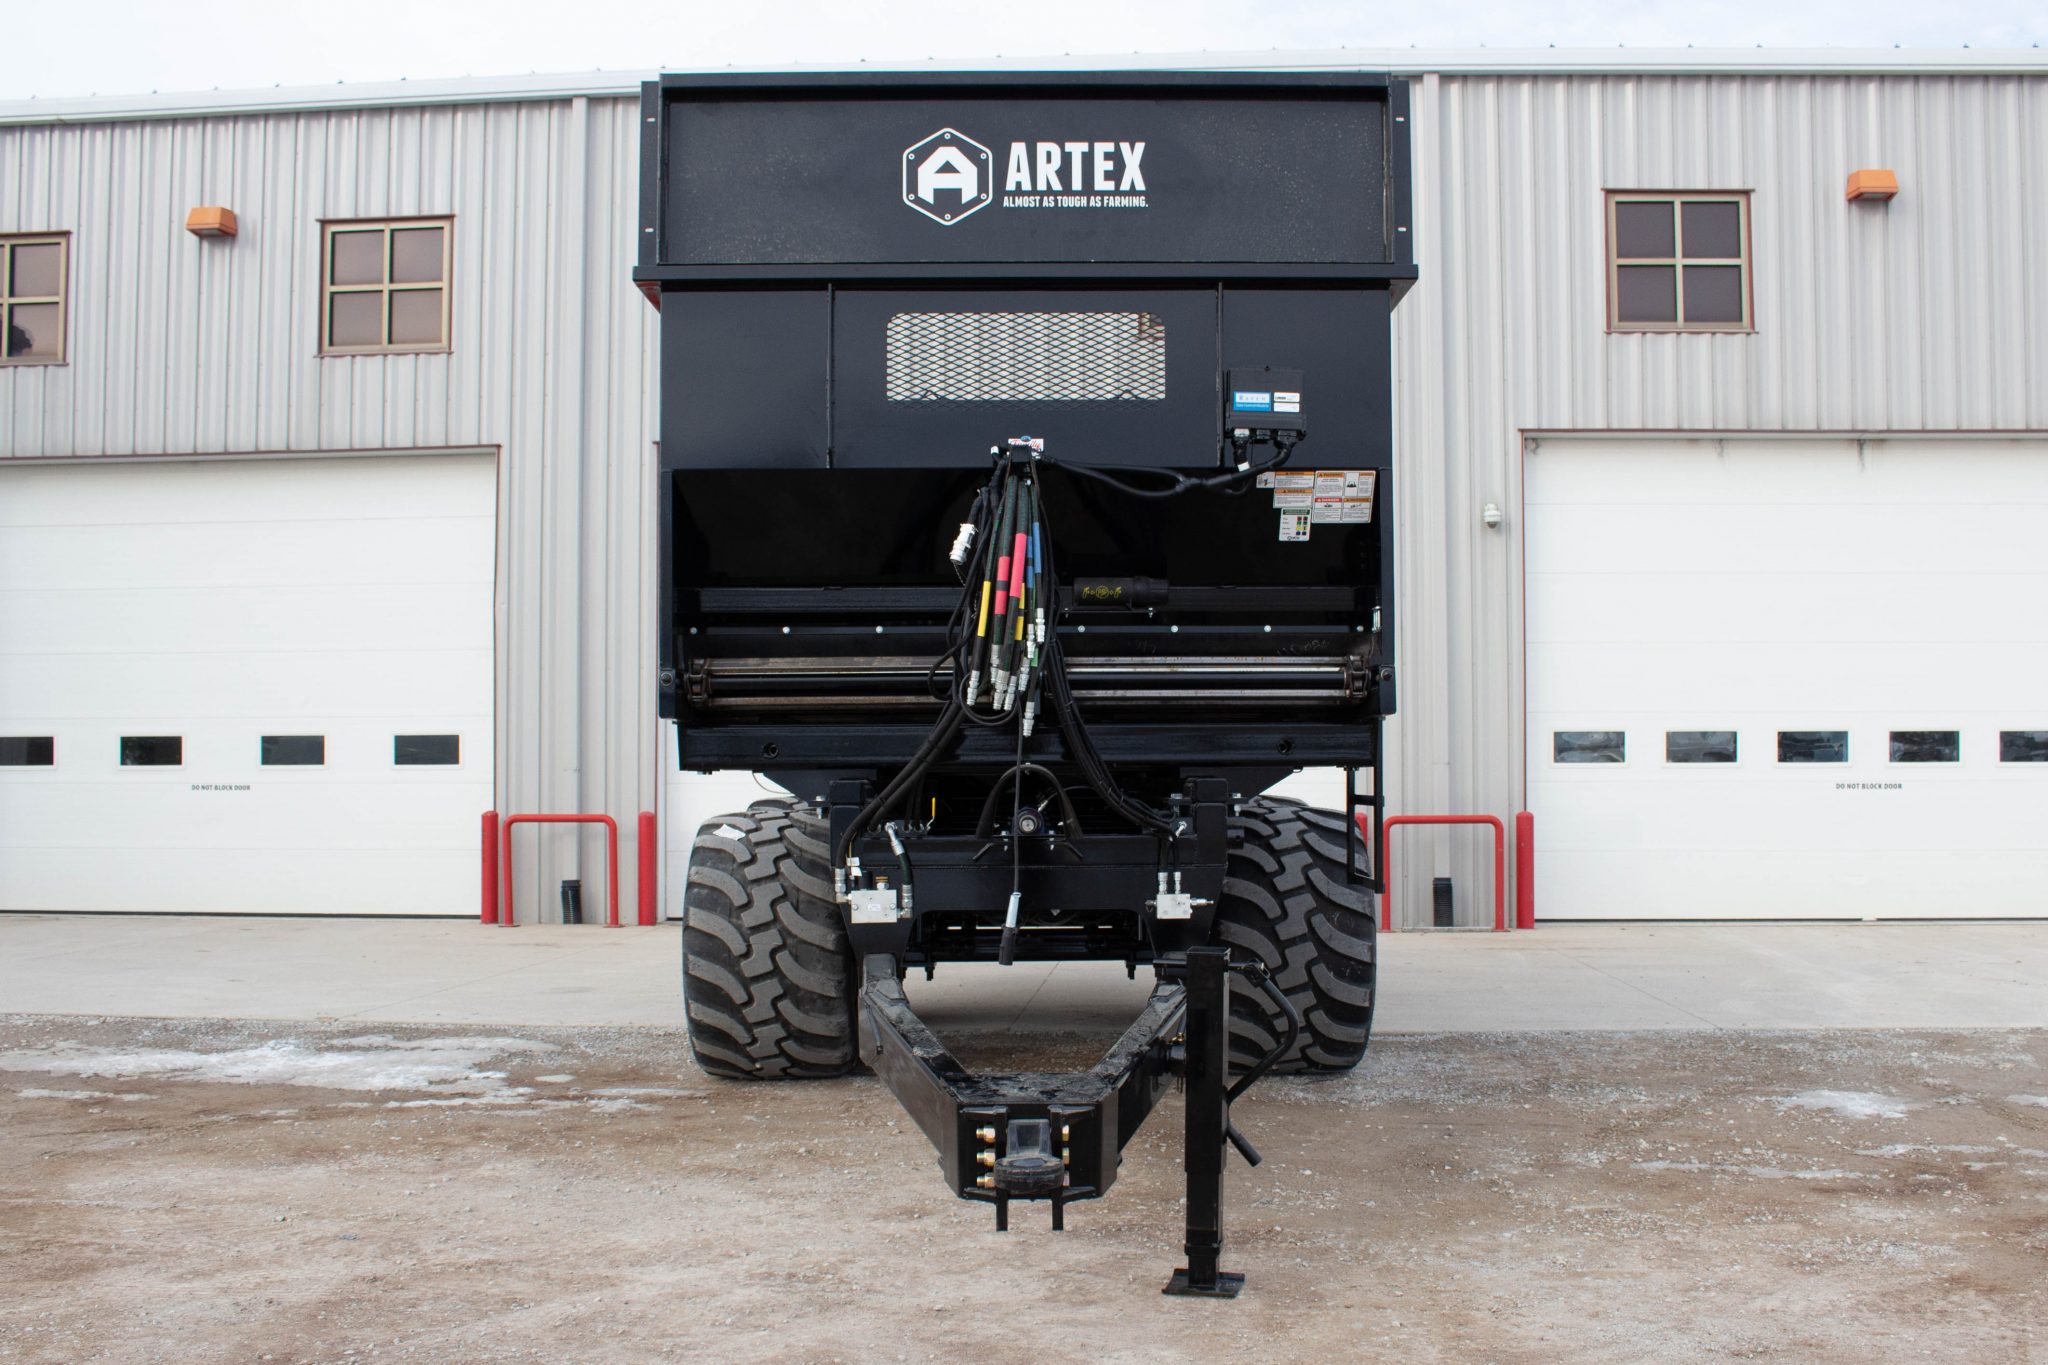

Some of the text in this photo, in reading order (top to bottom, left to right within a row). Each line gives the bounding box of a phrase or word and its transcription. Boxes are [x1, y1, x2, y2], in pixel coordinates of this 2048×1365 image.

[1005, 141, 1147, 191] ARTEX
[1003, 196, 1149, 208] ALMOST AS TOUGH AS FARMING.
